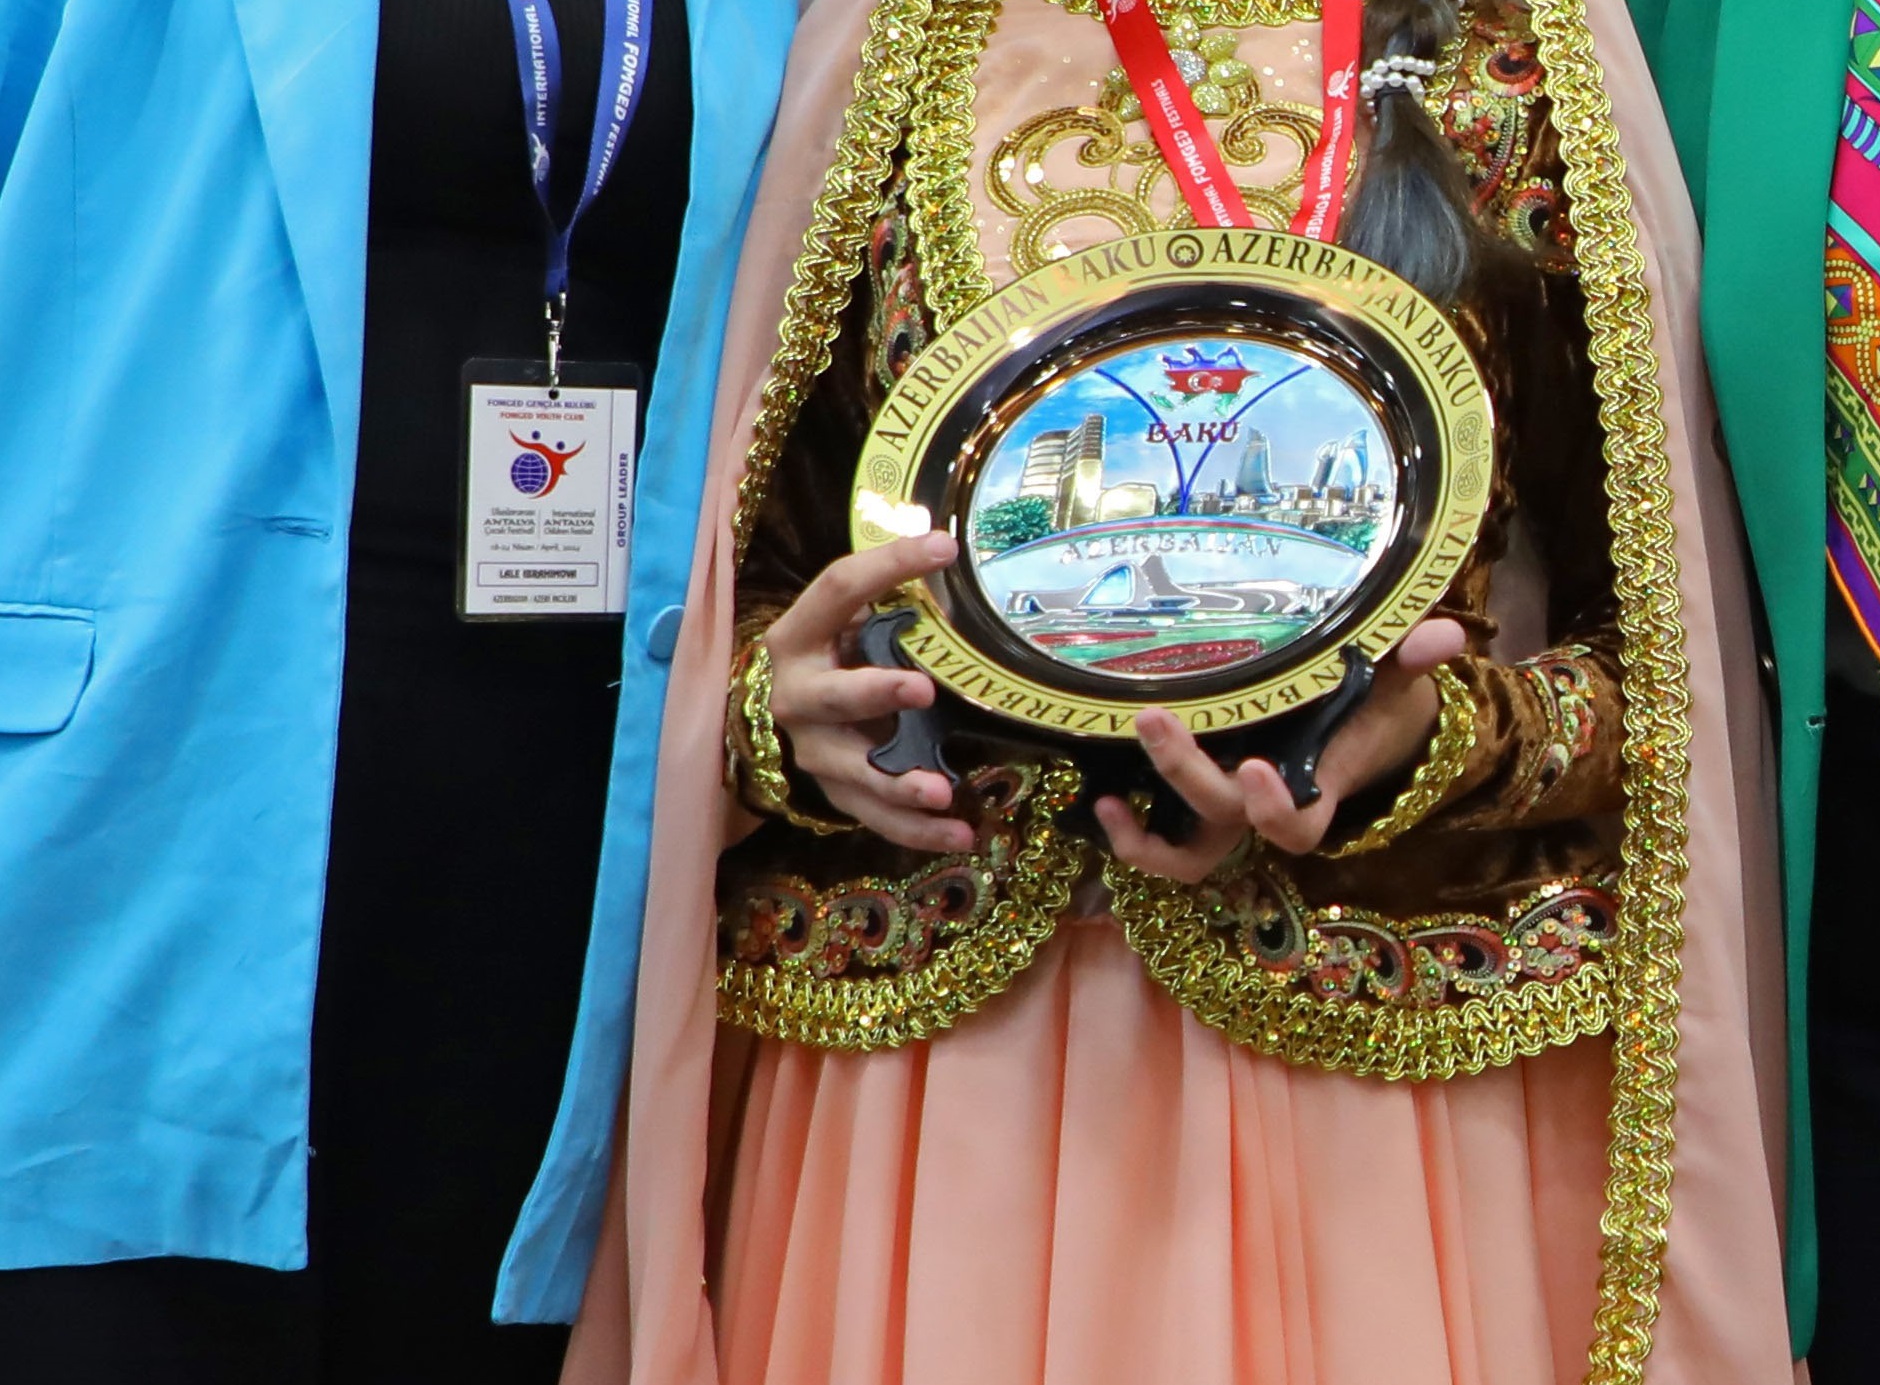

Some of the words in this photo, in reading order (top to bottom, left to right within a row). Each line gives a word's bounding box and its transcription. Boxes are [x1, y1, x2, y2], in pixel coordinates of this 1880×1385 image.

[531, 5, 547, 126] INTERNATIONAL
[614, 42, 640, 121] FOMGED
[1151, 79, 1182, 132] FESTIVALS
[1173, 132, 1212, 185] FOMGED
[875, 277, 1050, 452] AZERBAIJAN
[1051, 236, 1156, 292] BAKU
[1212, 232, 1430, 331] AZERBAIJAN
[1416, 314, 1482, 407] BAKU
[1147, 422, 1240, 443] BAKU
[618, 453, 629, 500] LEADER
[617, 503, 628, 548] GROUP
[1310, 509, 1479, 689] AZERBAIJN
[907, 633, 1138, 734] AZERBAIJAN
[1190, 686, 1304, 731] BAKU
